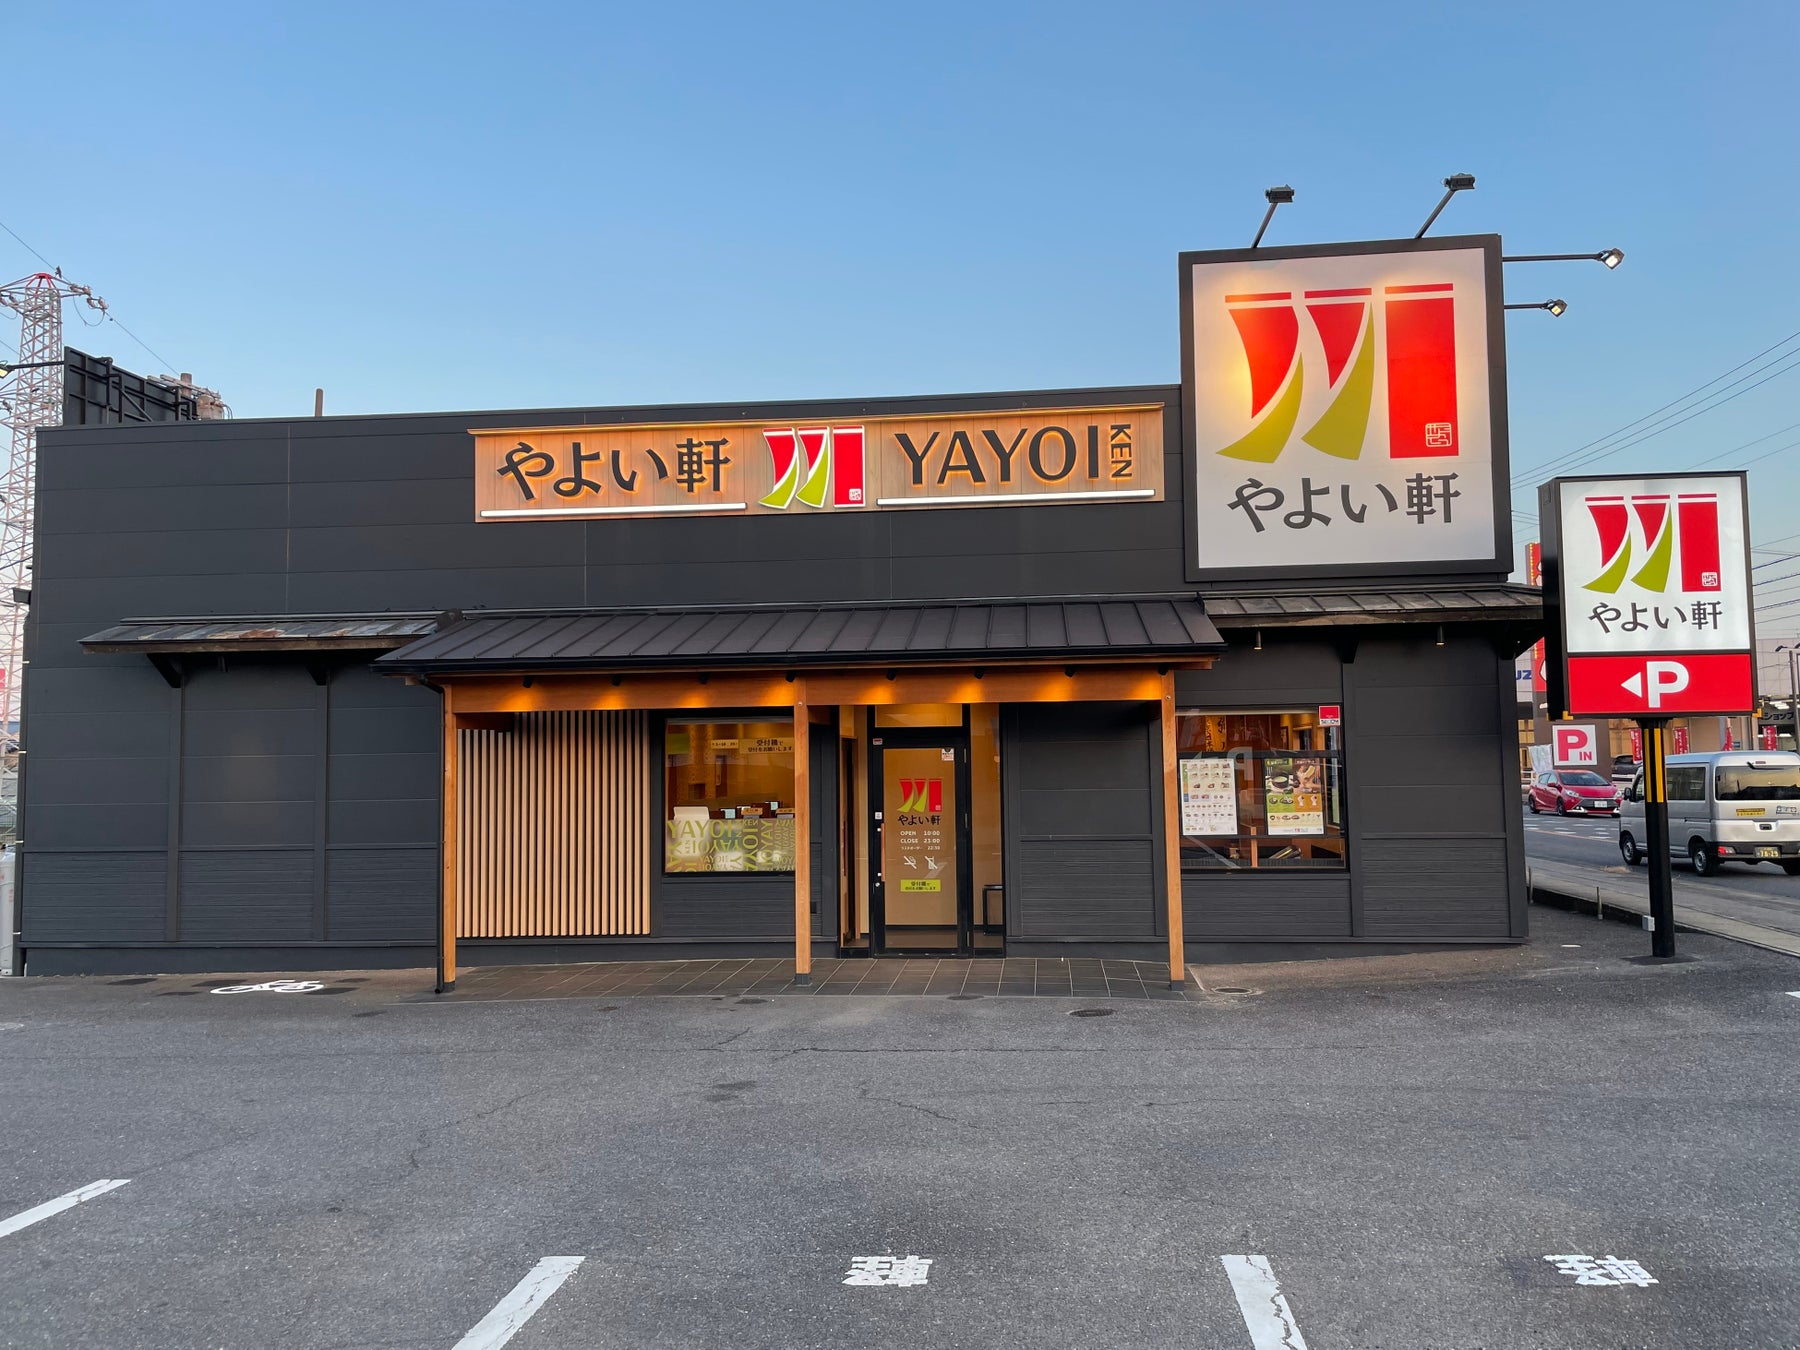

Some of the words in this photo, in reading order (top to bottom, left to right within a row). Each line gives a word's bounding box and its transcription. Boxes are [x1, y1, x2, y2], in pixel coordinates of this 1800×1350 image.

[497, 438, 729, 500] やよい軒
[895, 424, 1099, 486] YAYOI
[1109, 423, 1133, 478] KEN
[1226, 472, 1462, 533] やよい軒
[1588, 600, 1723, 634] やよい軒
[1646, 660, 1690, 708] P
[1557, 729, 1588, 762] P
[1579, 751, 1592, 761] IN
[667, 820, 732, 839] YAYOI
[898, 814, 942, 826] やよい軒
